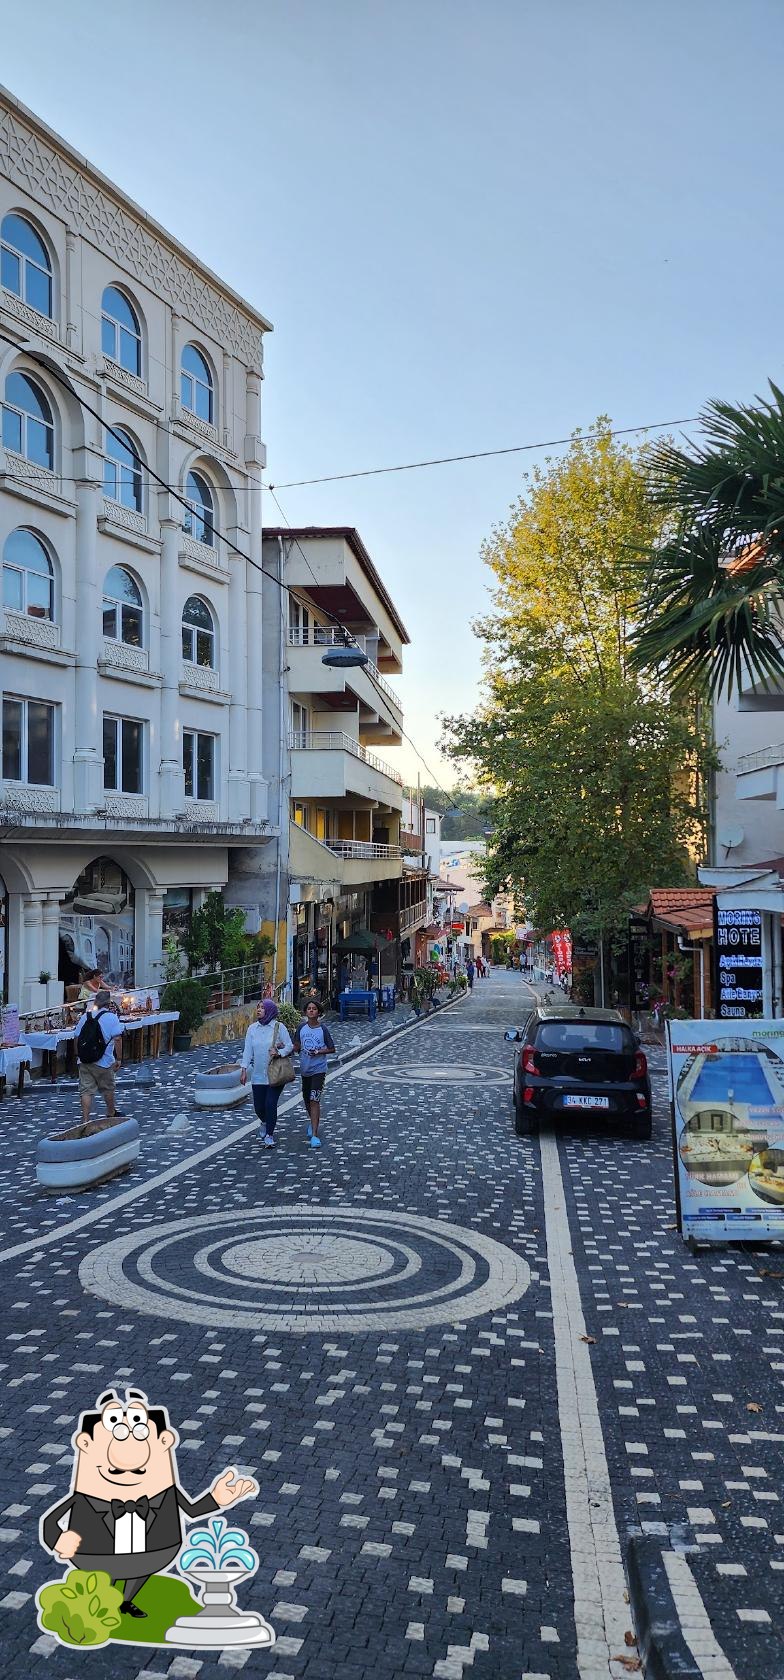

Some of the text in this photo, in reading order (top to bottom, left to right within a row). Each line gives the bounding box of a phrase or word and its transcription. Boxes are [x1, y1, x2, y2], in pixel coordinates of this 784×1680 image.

[720, 971, 736, 986] Spa
[721, 1004, 746, 1017] Sauna
[567, 1096, 576, 1104] 34
[594, 1097, 607, 1106] 271
